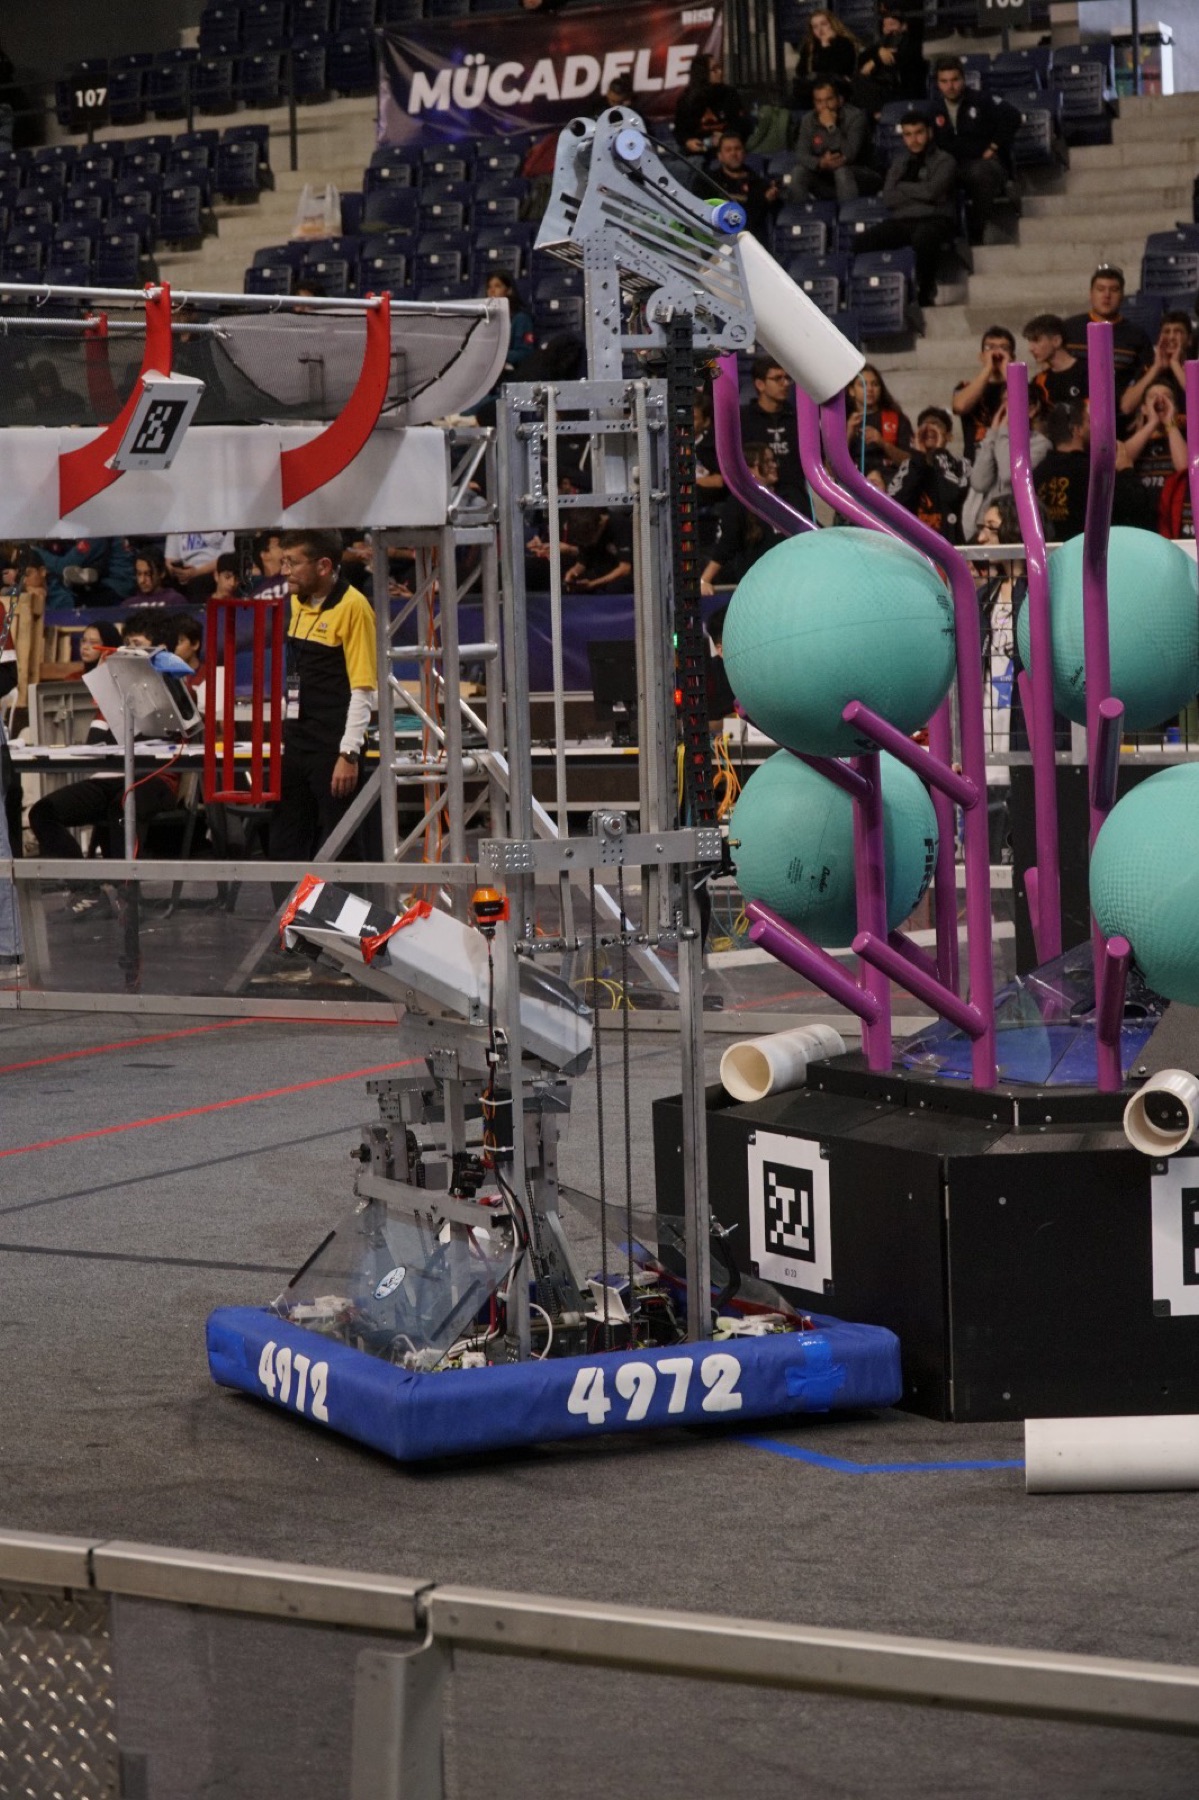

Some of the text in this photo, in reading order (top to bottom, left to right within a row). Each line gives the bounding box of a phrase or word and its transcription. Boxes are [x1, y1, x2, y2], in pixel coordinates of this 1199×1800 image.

[75, 87, 107, 107] 107
[258, 1341, 329, 1422] 4972
[568, 1354, 742, 1424] 4972
